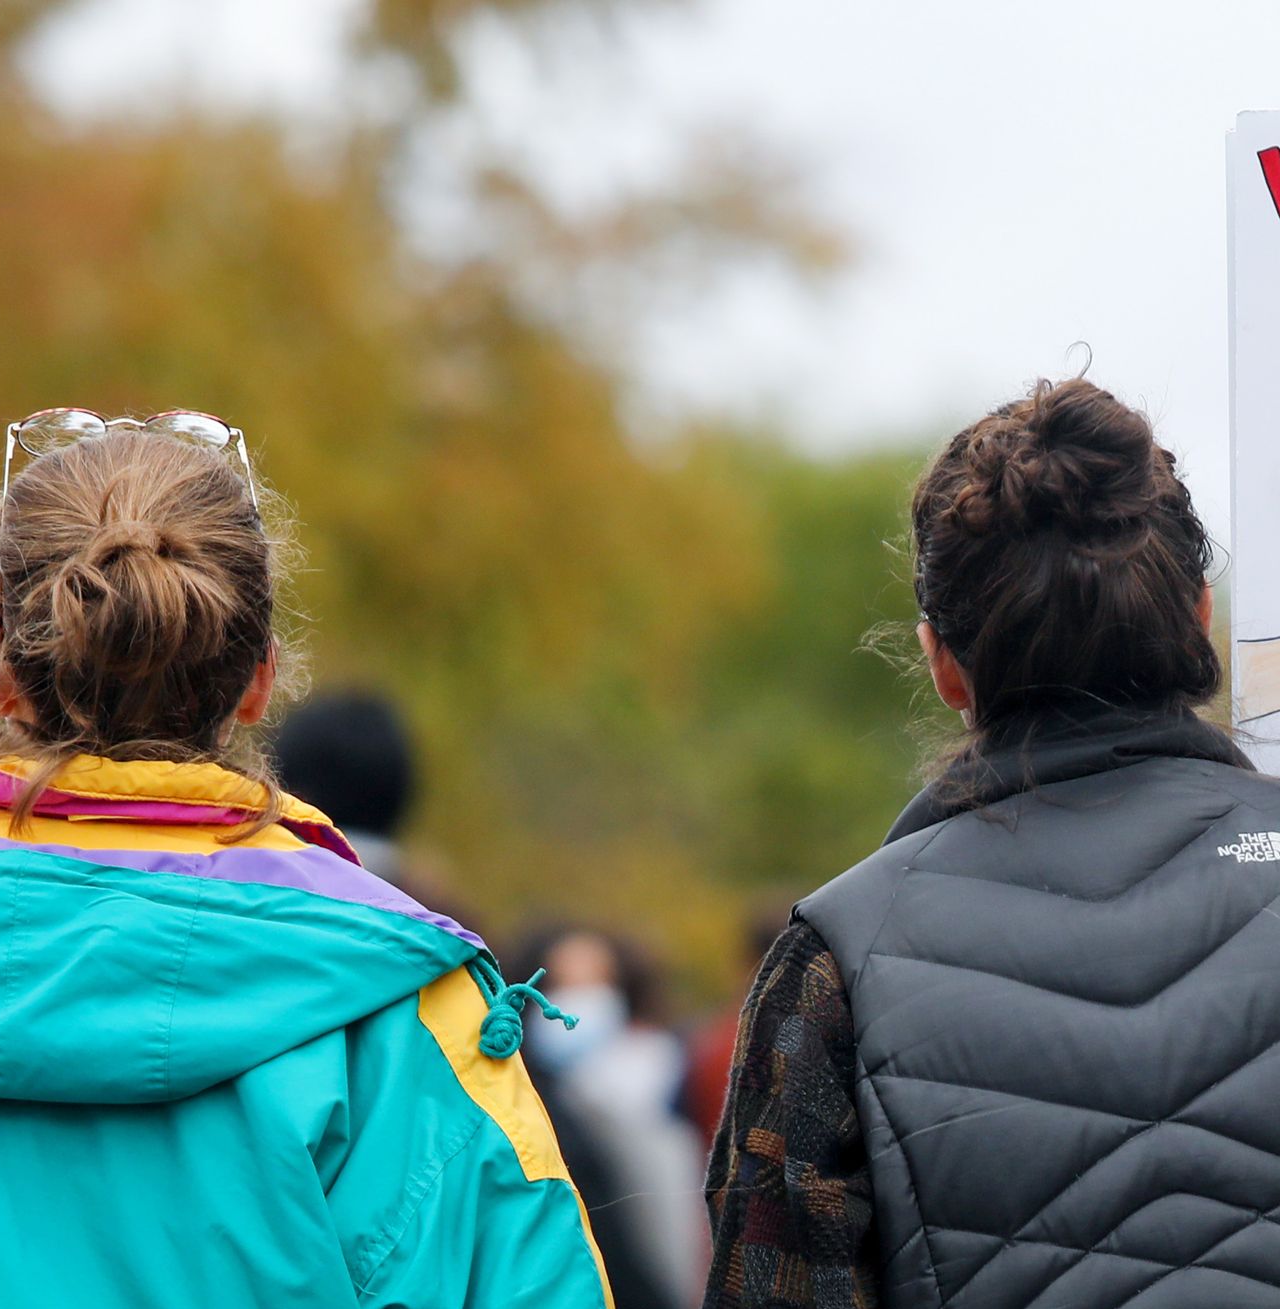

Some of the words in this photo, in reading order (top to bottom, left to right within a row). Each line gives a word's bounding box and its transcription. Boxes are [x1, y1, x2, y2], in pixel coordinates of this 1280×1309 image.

[1238, 832, 1268, 843] THE
[1217, 841, 1272, 857] NORTH
[1236, 851, 1275, 863] FACE
